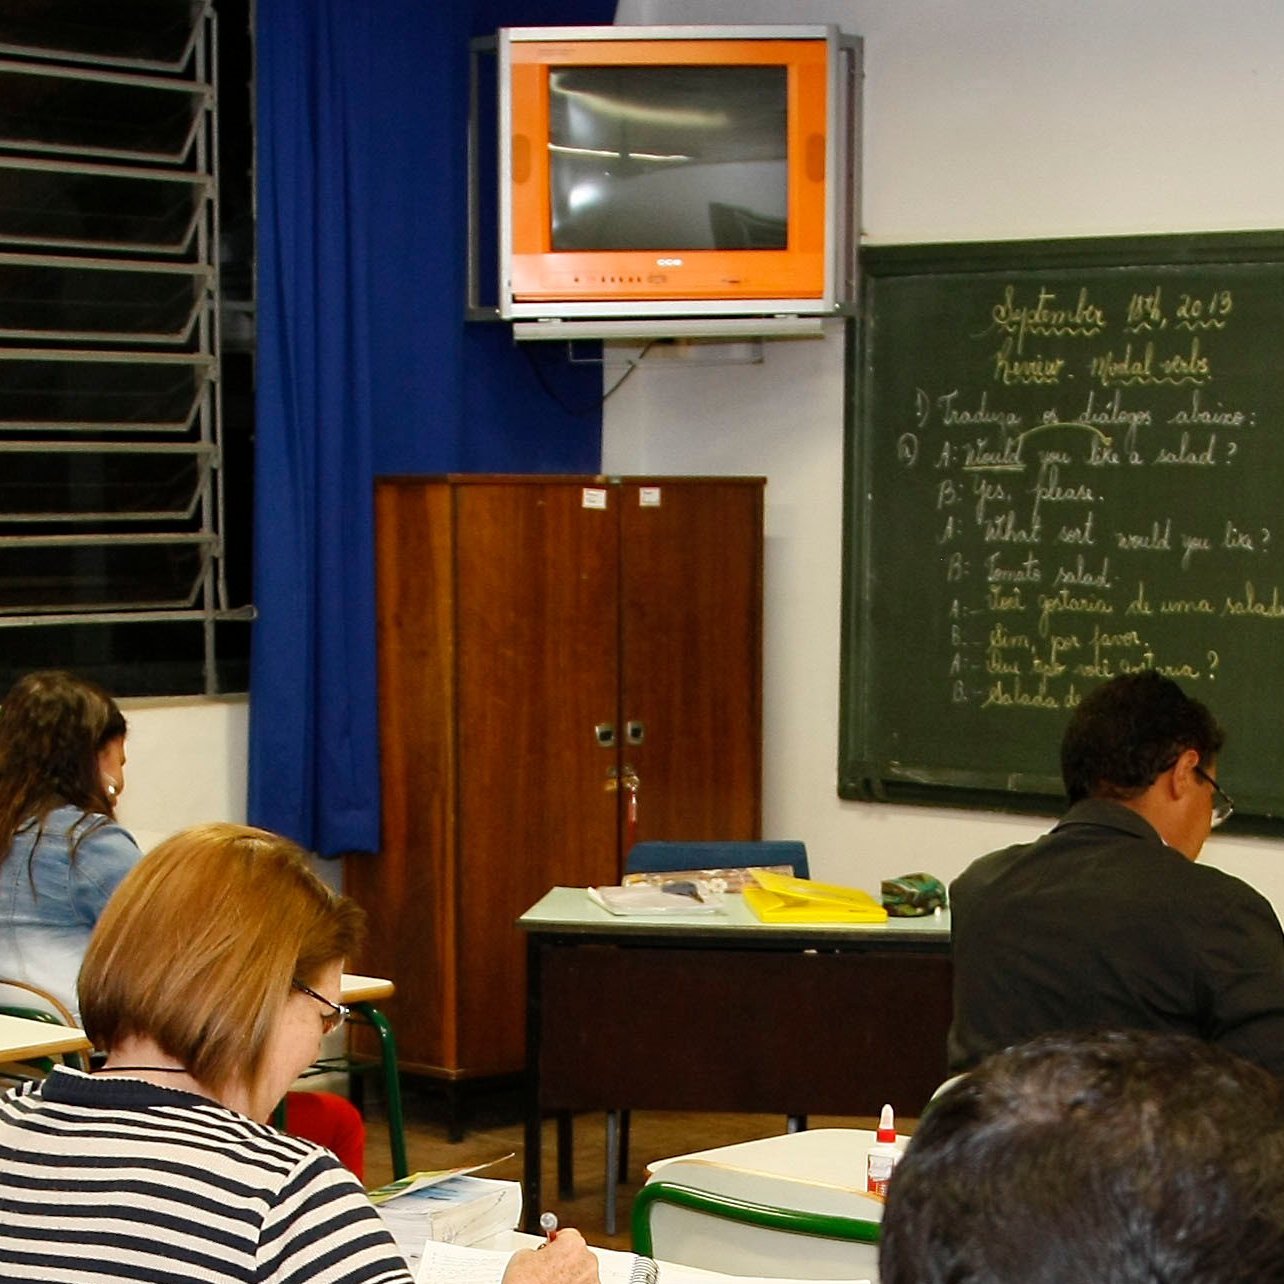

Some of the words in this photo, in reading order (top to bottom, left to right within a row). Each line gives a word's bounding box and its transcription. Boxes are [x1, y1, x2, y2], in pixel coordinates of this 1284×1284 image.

[992, 285, 1107, 354] September
[1090, 343, 1154, 386] Modal
[963, 436, 1022, 466] Would
[984, 510, 1042, 542] What
[1116, 517, 1172, 550] would
[984, 551, 1042, 584] Tomato
